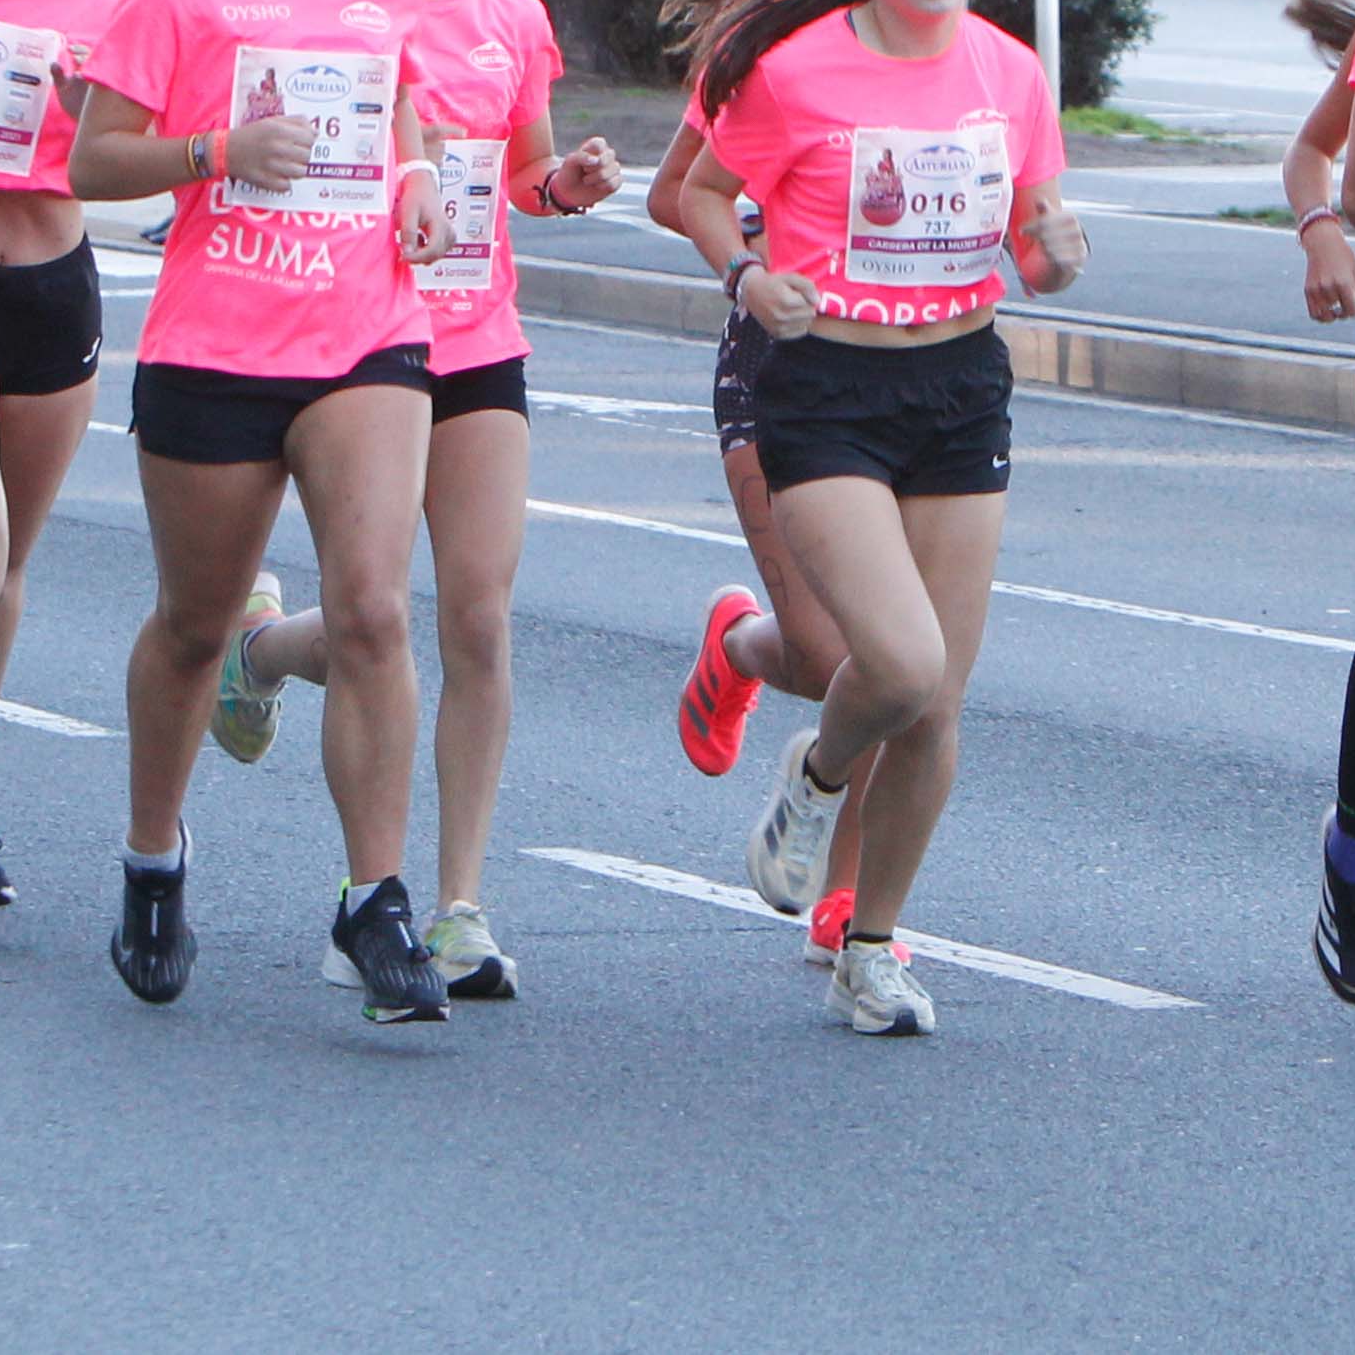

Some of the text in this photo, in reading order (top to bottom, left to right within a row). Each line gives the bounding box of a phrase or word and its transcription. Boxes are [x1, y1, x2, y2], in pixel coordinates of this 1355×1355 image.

[222, 4, 292, 22] OYSHO
[292, 78, 347, 94] ASTURIANA
[310, 115, 342, 139] 16
[911, 156, 972, 171] ASTURIANA
[309, 165, 321, 176] LA
[324, 165, 353, 178] MUJER
[331, 188, 375, 201] Santander
[911, 192, 966, 214] 016
[924, 220, 951, 235] 737
[206, 223, 336, 279] SUMA
[868, 238, 916, 253] CARRERA
[917, 240, 931, 253] DE
[933, 240, 947, 253] LA
[862, 260, 915, 275] OYSHO
